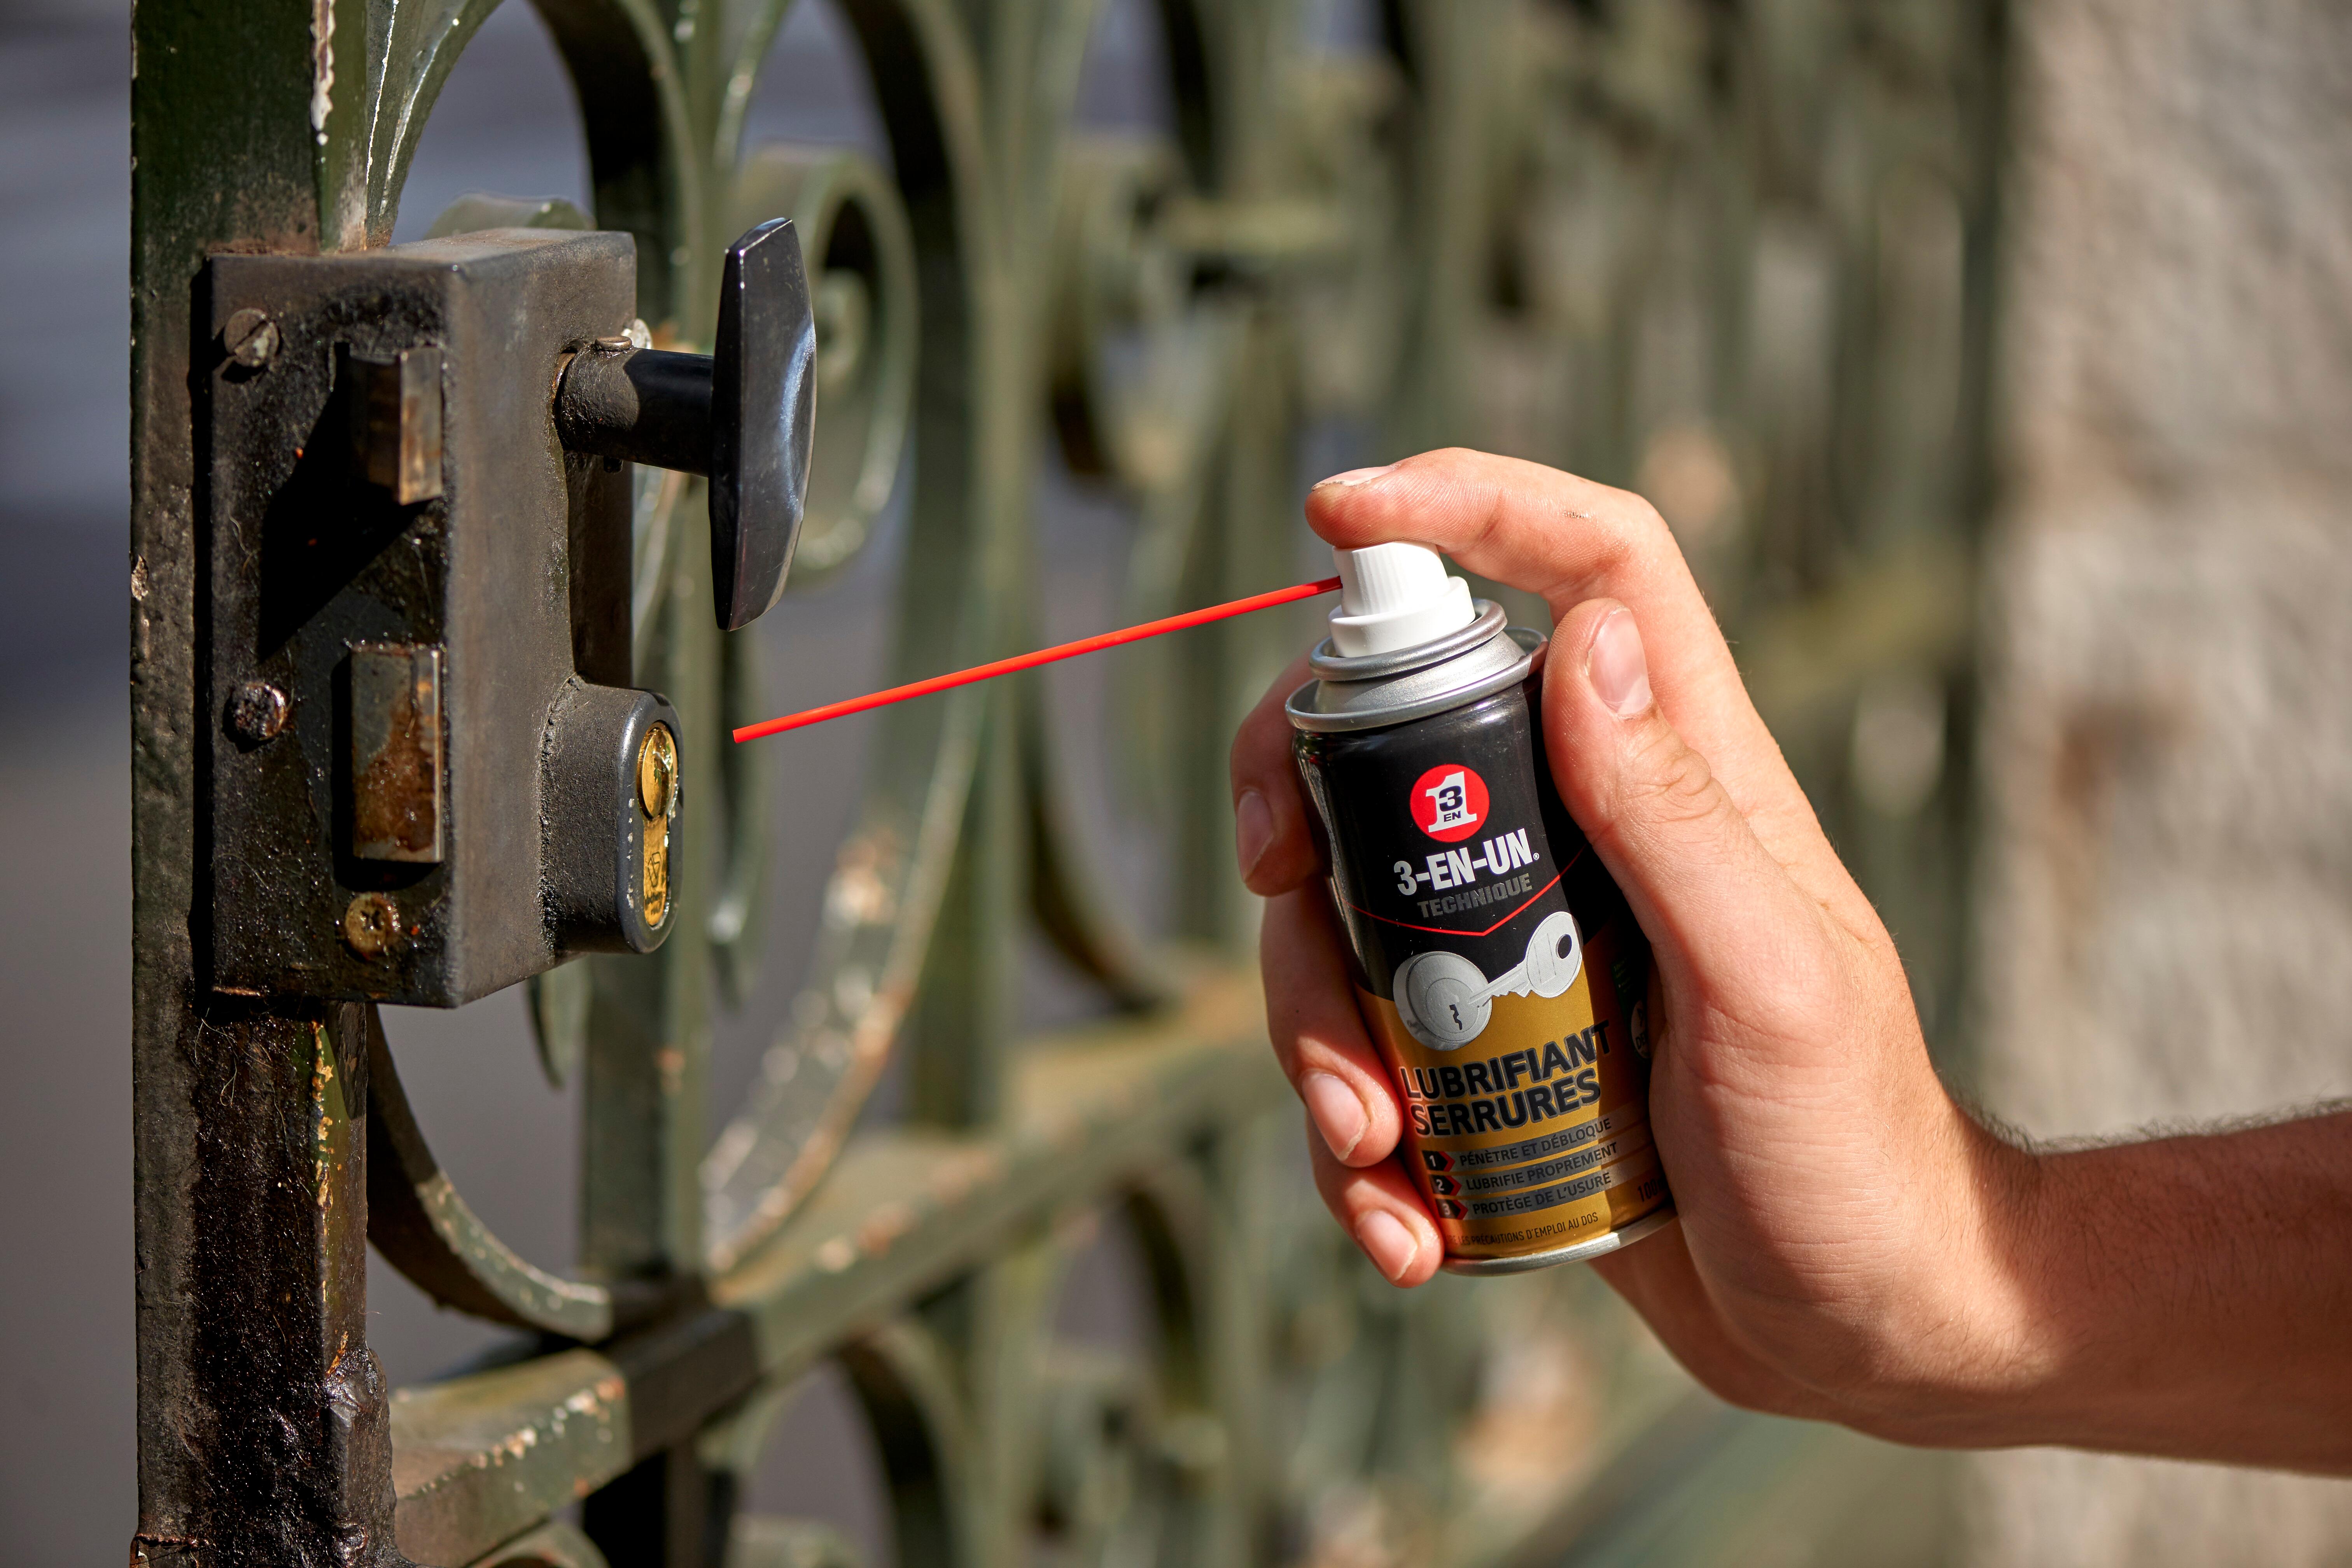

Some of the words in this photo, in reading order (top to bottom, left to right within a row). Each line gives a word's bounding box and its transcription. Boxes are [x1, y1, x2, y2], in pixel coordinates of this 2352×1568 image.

[1439, 786, 1463, 812] 3
[1444, 810, 1461, 822] EN
[1417, 873, 1533, 918] TECHNIQUE
[1399, 1020, 1610, 1101] LUBRIFIANT
[1410, 1068, 1601, 1138] SERRURES
[1429, 1155, 1436, 1167] 1
[1460, 1146, 1519, 1166] PÉNÈTRE
[1521, 1143, 1537, 1156] ET
[1540, 1118, 1612, 1151] DÉBLOQUE
[1437, 1180, 1445, 1191] 2
[1466, 1172, 1525, 1190] LUBRIFIE
[1528, 1142, 1617, 1181] PROPREMENT
[1442, 1202, 1450, 1215] 3
[1473, 1195, 1532, 1214] PROTÈGE
[1535, 1190, 1553, 1205] DE
[1557, 1172, 1612, 1200] L'USURE
[1471, 1231, 1524, 1245] PRÉCAUTIONS
[1526, 1221, 1566, 1239] D'EMPLOI
[1568, 1218, 1579, 1230] AU
[1581, 1212, 1598, 1226] DOS
